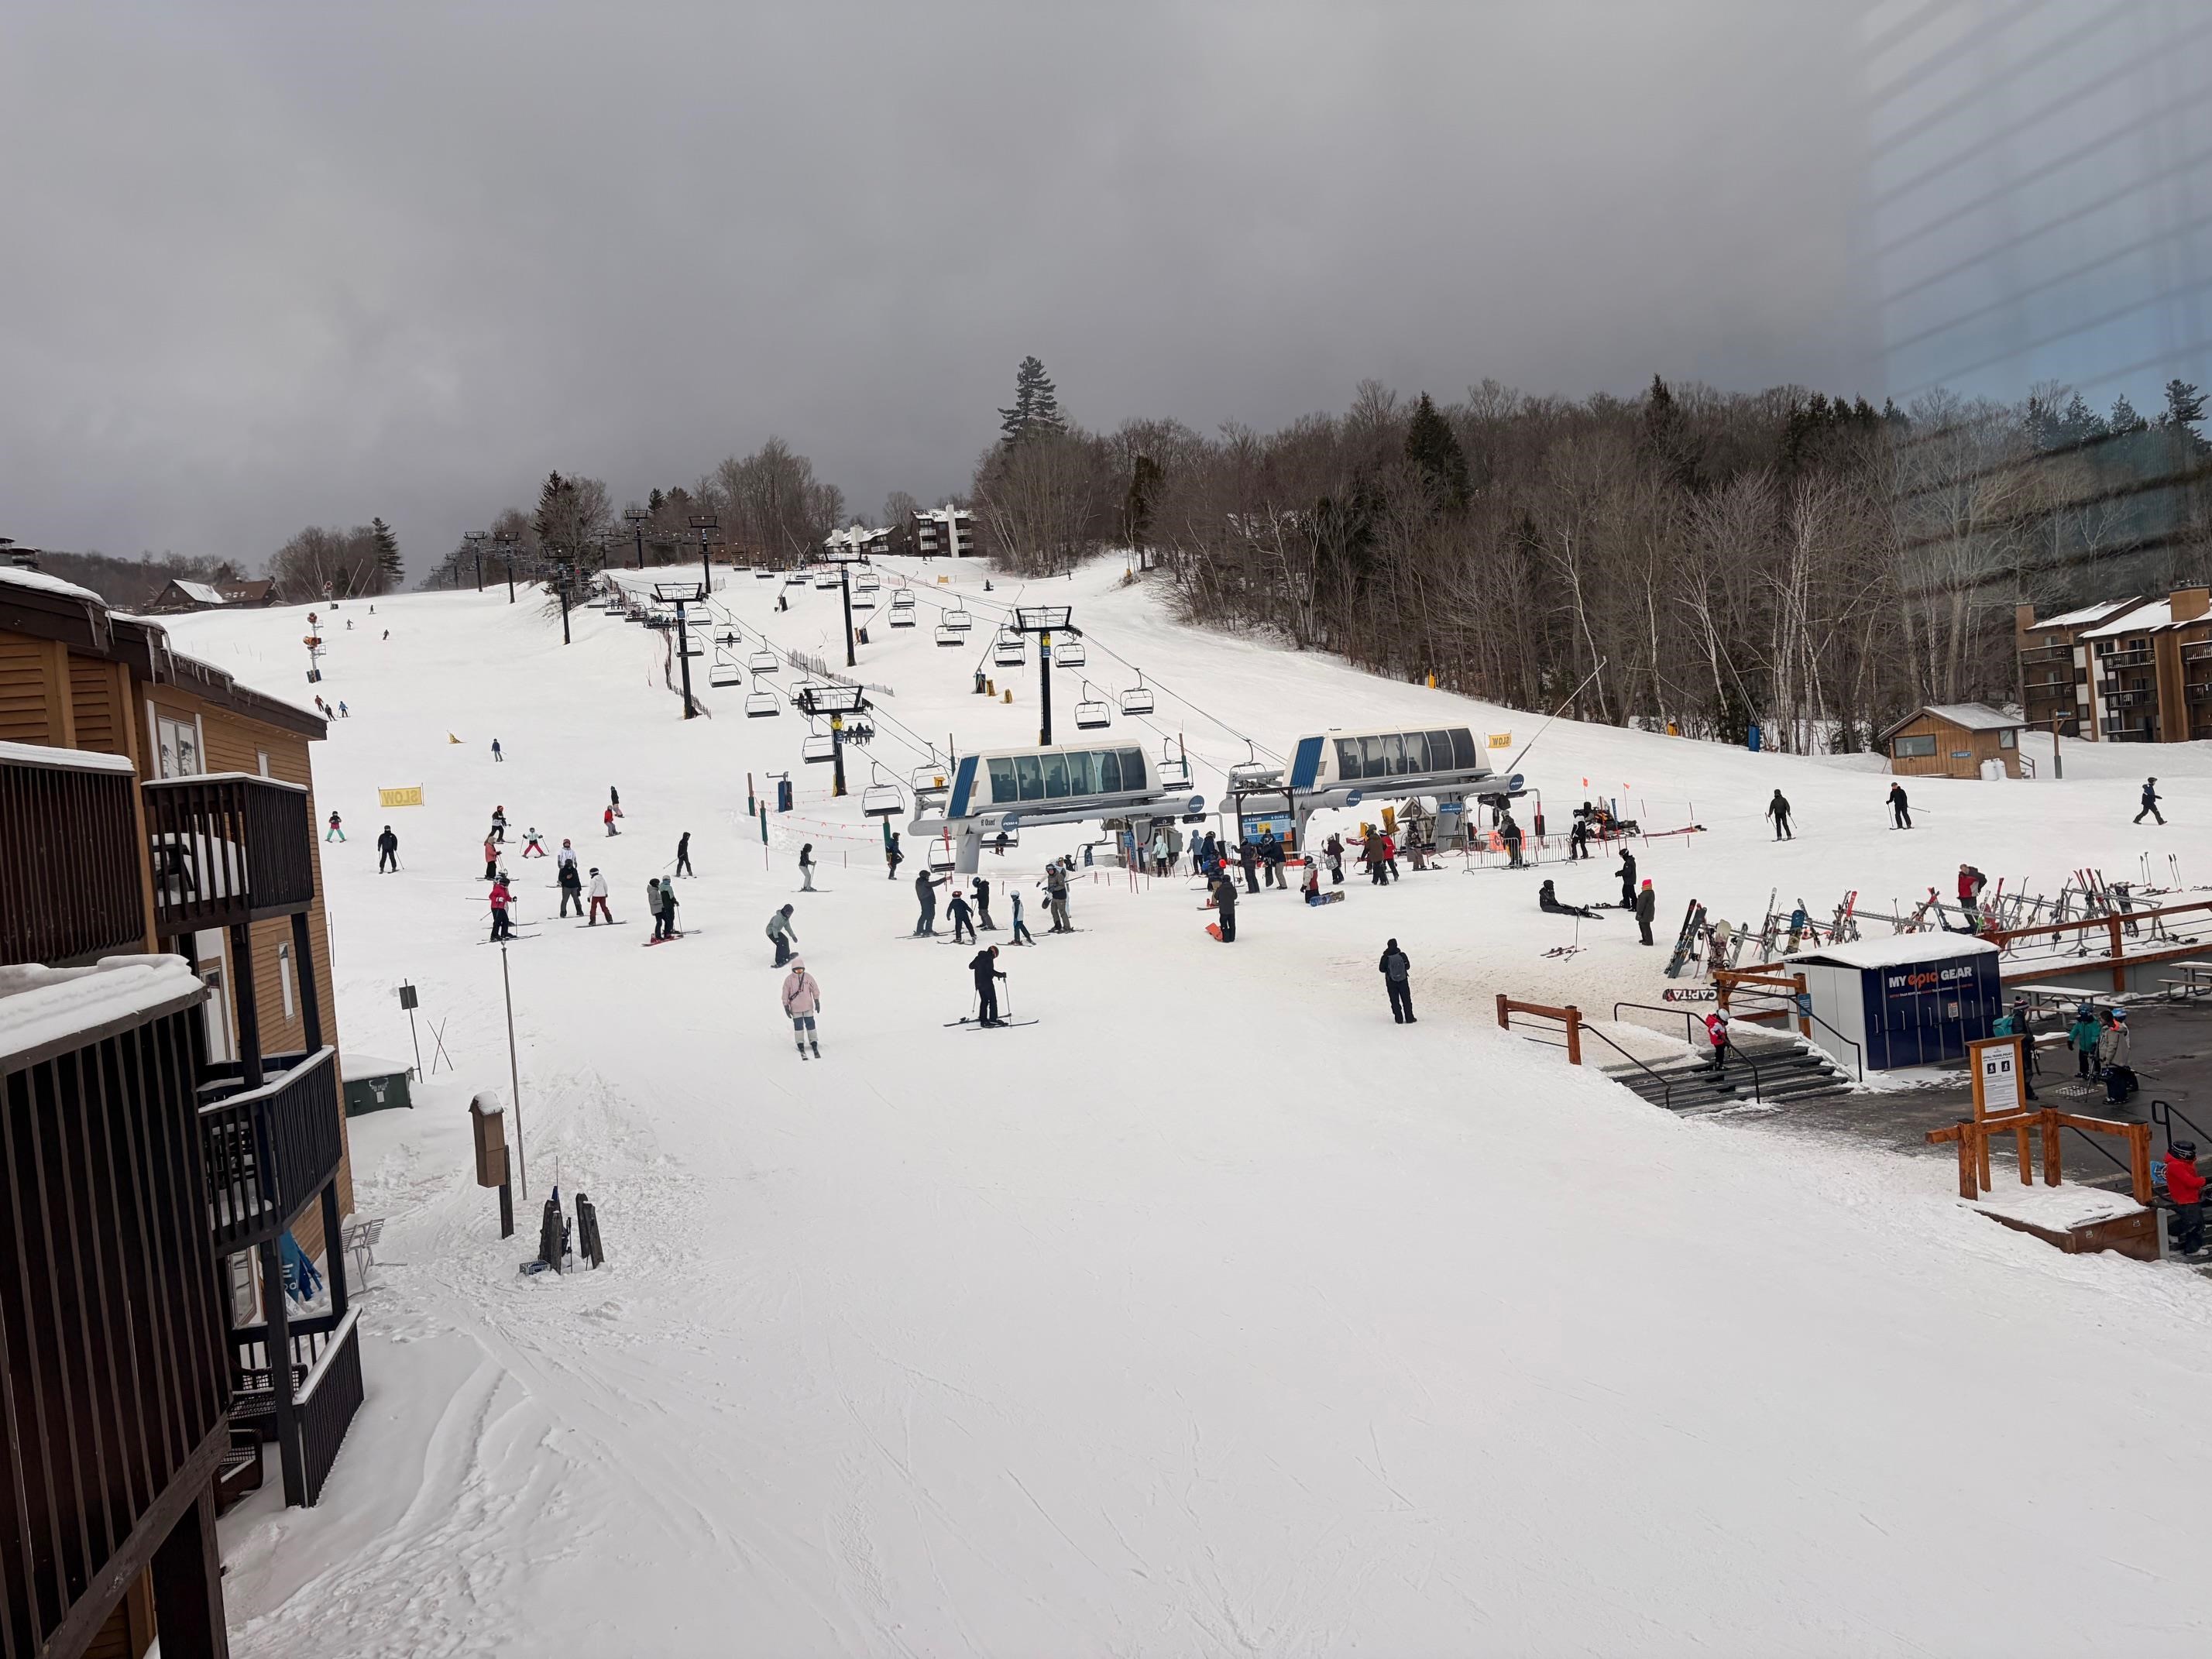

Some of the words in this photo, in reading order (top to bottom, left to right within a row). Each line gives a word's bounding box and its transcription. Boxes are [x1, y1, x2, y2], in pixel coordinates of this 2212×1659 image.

[1889, 976, 1906, 988] MY
[1908, 971, 1939, 989] epic
[1940, 966, 1973, 981] GEAR
[1673, 990, 1718, 1000] CAPiTA
